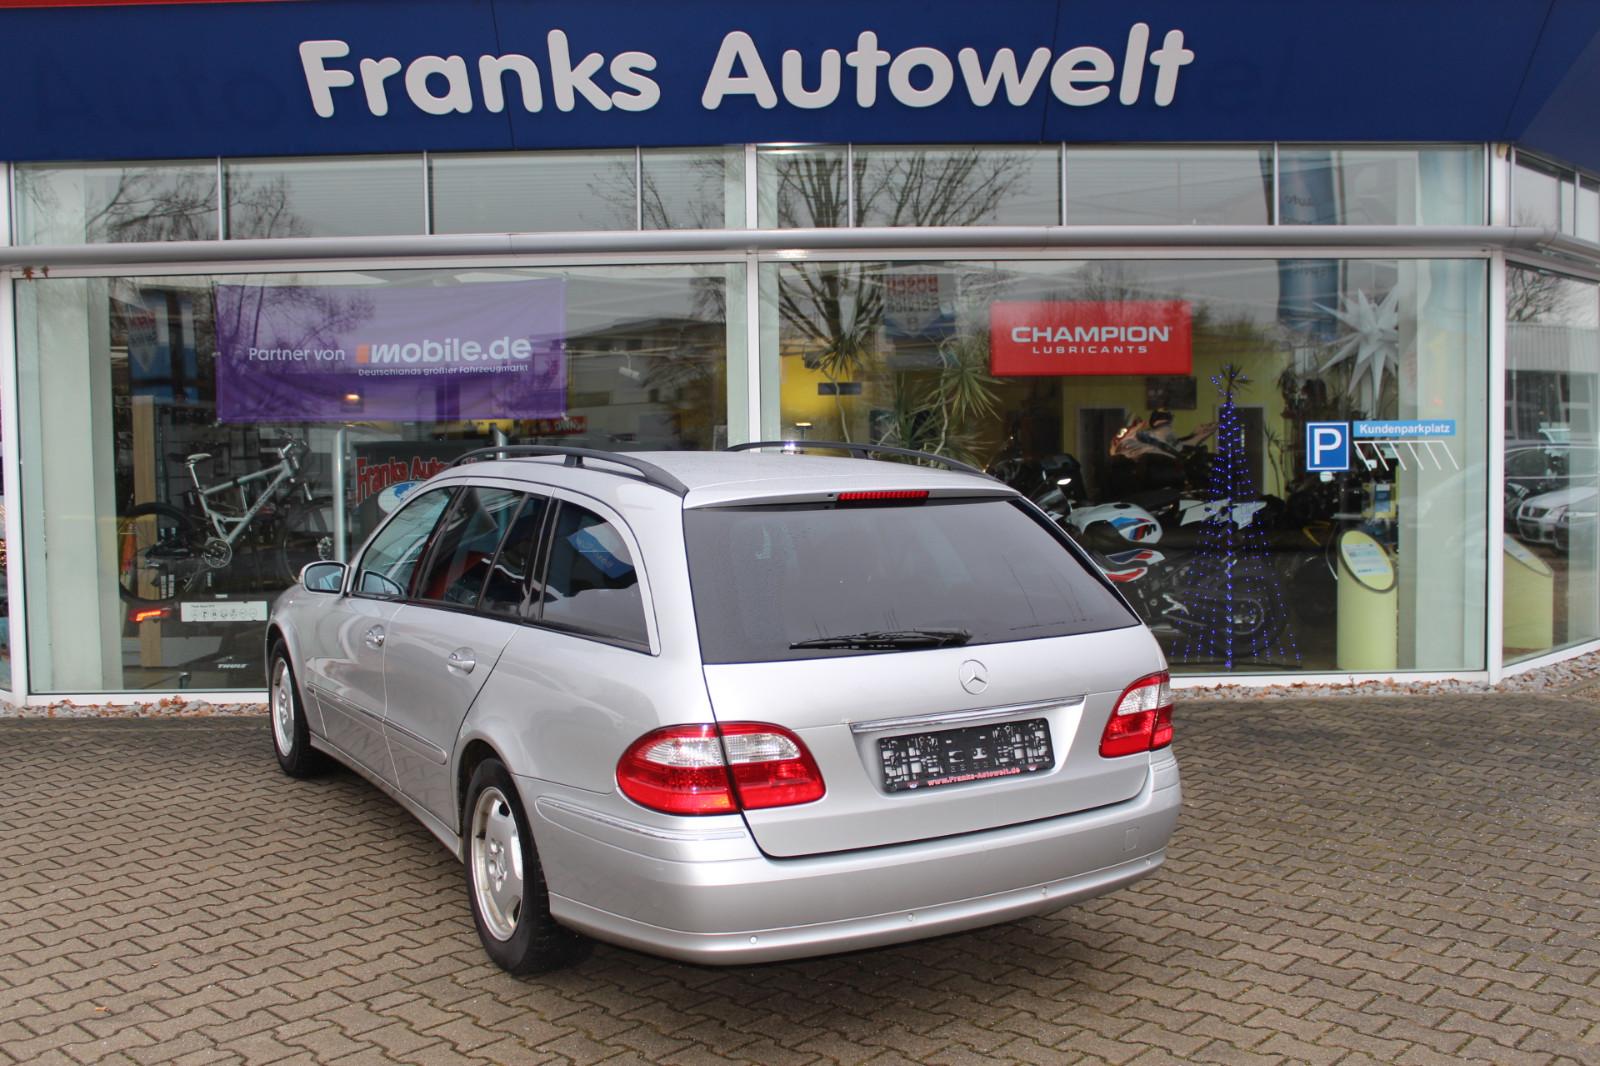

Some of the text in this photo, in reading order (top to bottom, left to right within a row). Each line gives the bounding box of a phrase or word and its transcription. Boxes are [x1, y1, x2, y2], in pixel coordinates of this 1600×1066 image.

[298, 28, 661, 118] Franks
[700, 22, 1195, 110] Autowelt
[1010, 325, 1170, 343] CHAMPION
[248, 347, 345, 361] Partner von
[370, 336, 532, 363] mobile.de
[1032, 345, 1148, 354] LUBRICANTS
[1359, 422, 1450, 436] Kundenparkplatz
[1314, 428, 1342, 464] P
[356, 456, 408, 507] Franks
